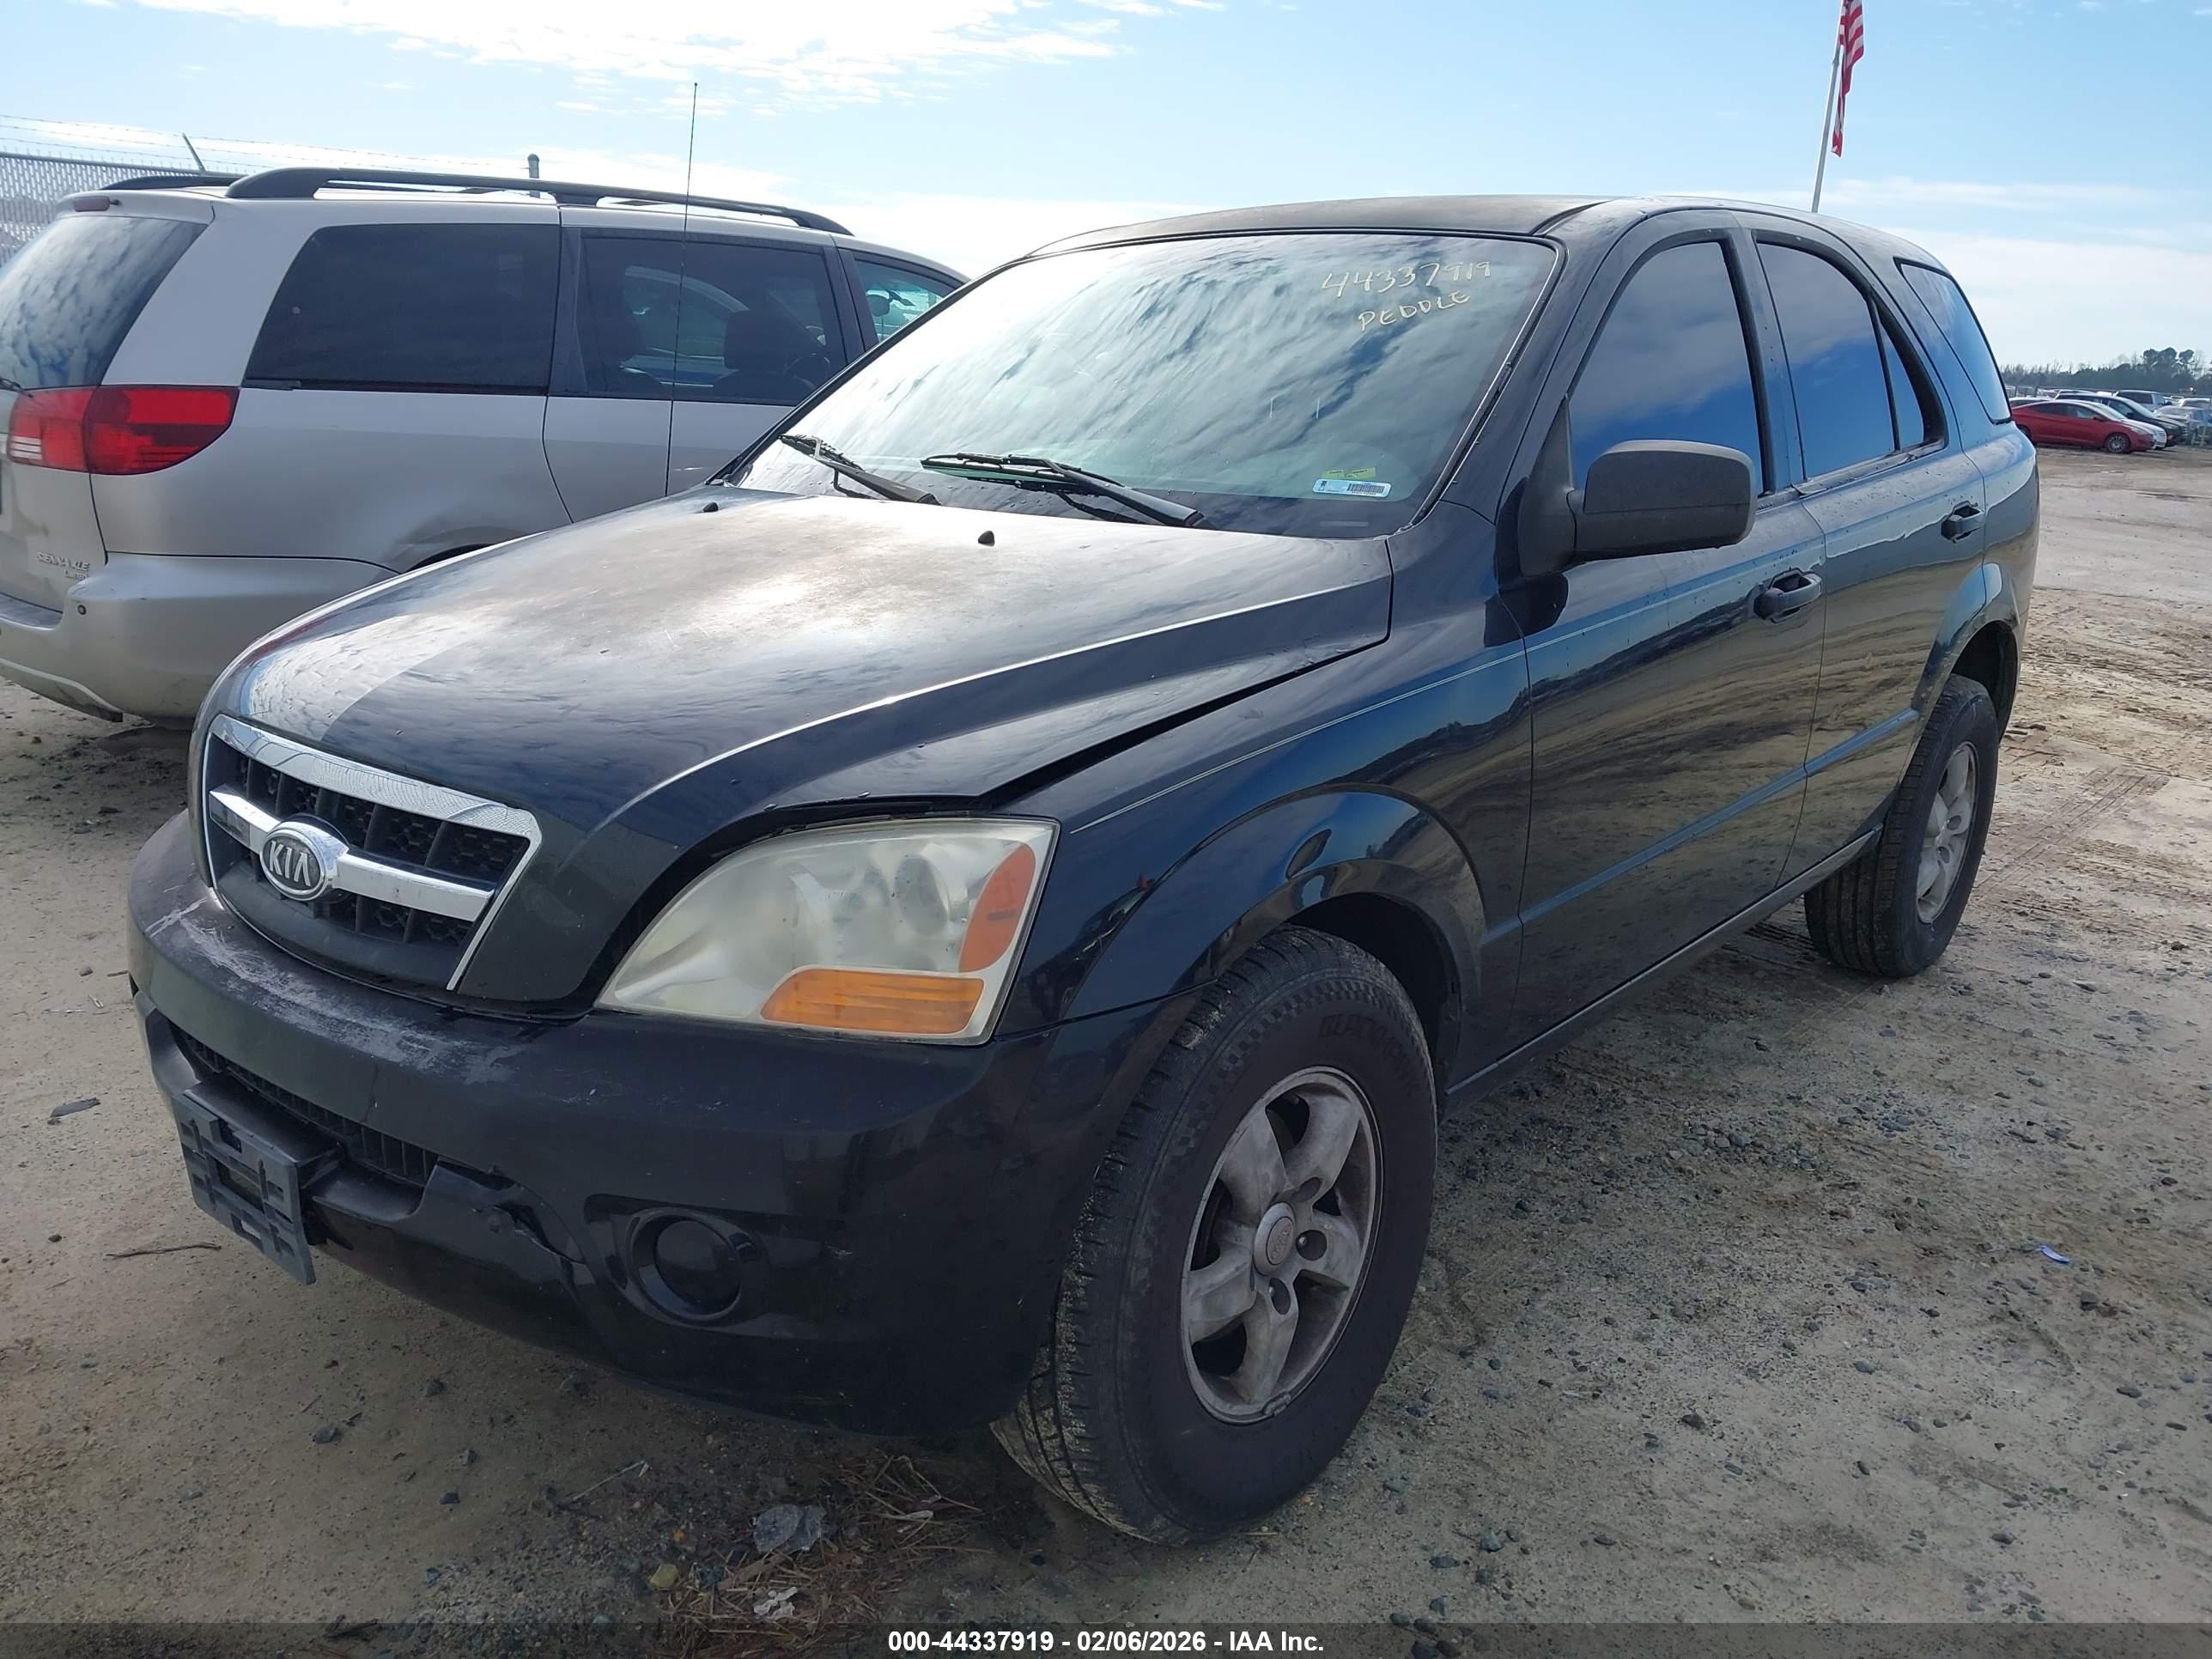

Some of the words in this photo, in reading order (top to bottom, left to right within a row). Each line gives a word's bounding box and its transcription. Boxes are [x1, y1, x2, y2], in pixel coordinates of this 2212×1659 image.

[1321, 260, 1492, 298] 44337919
[1358, 289, 1471, 331] PEDDLE
[269, 840, 311, 887] KIA
